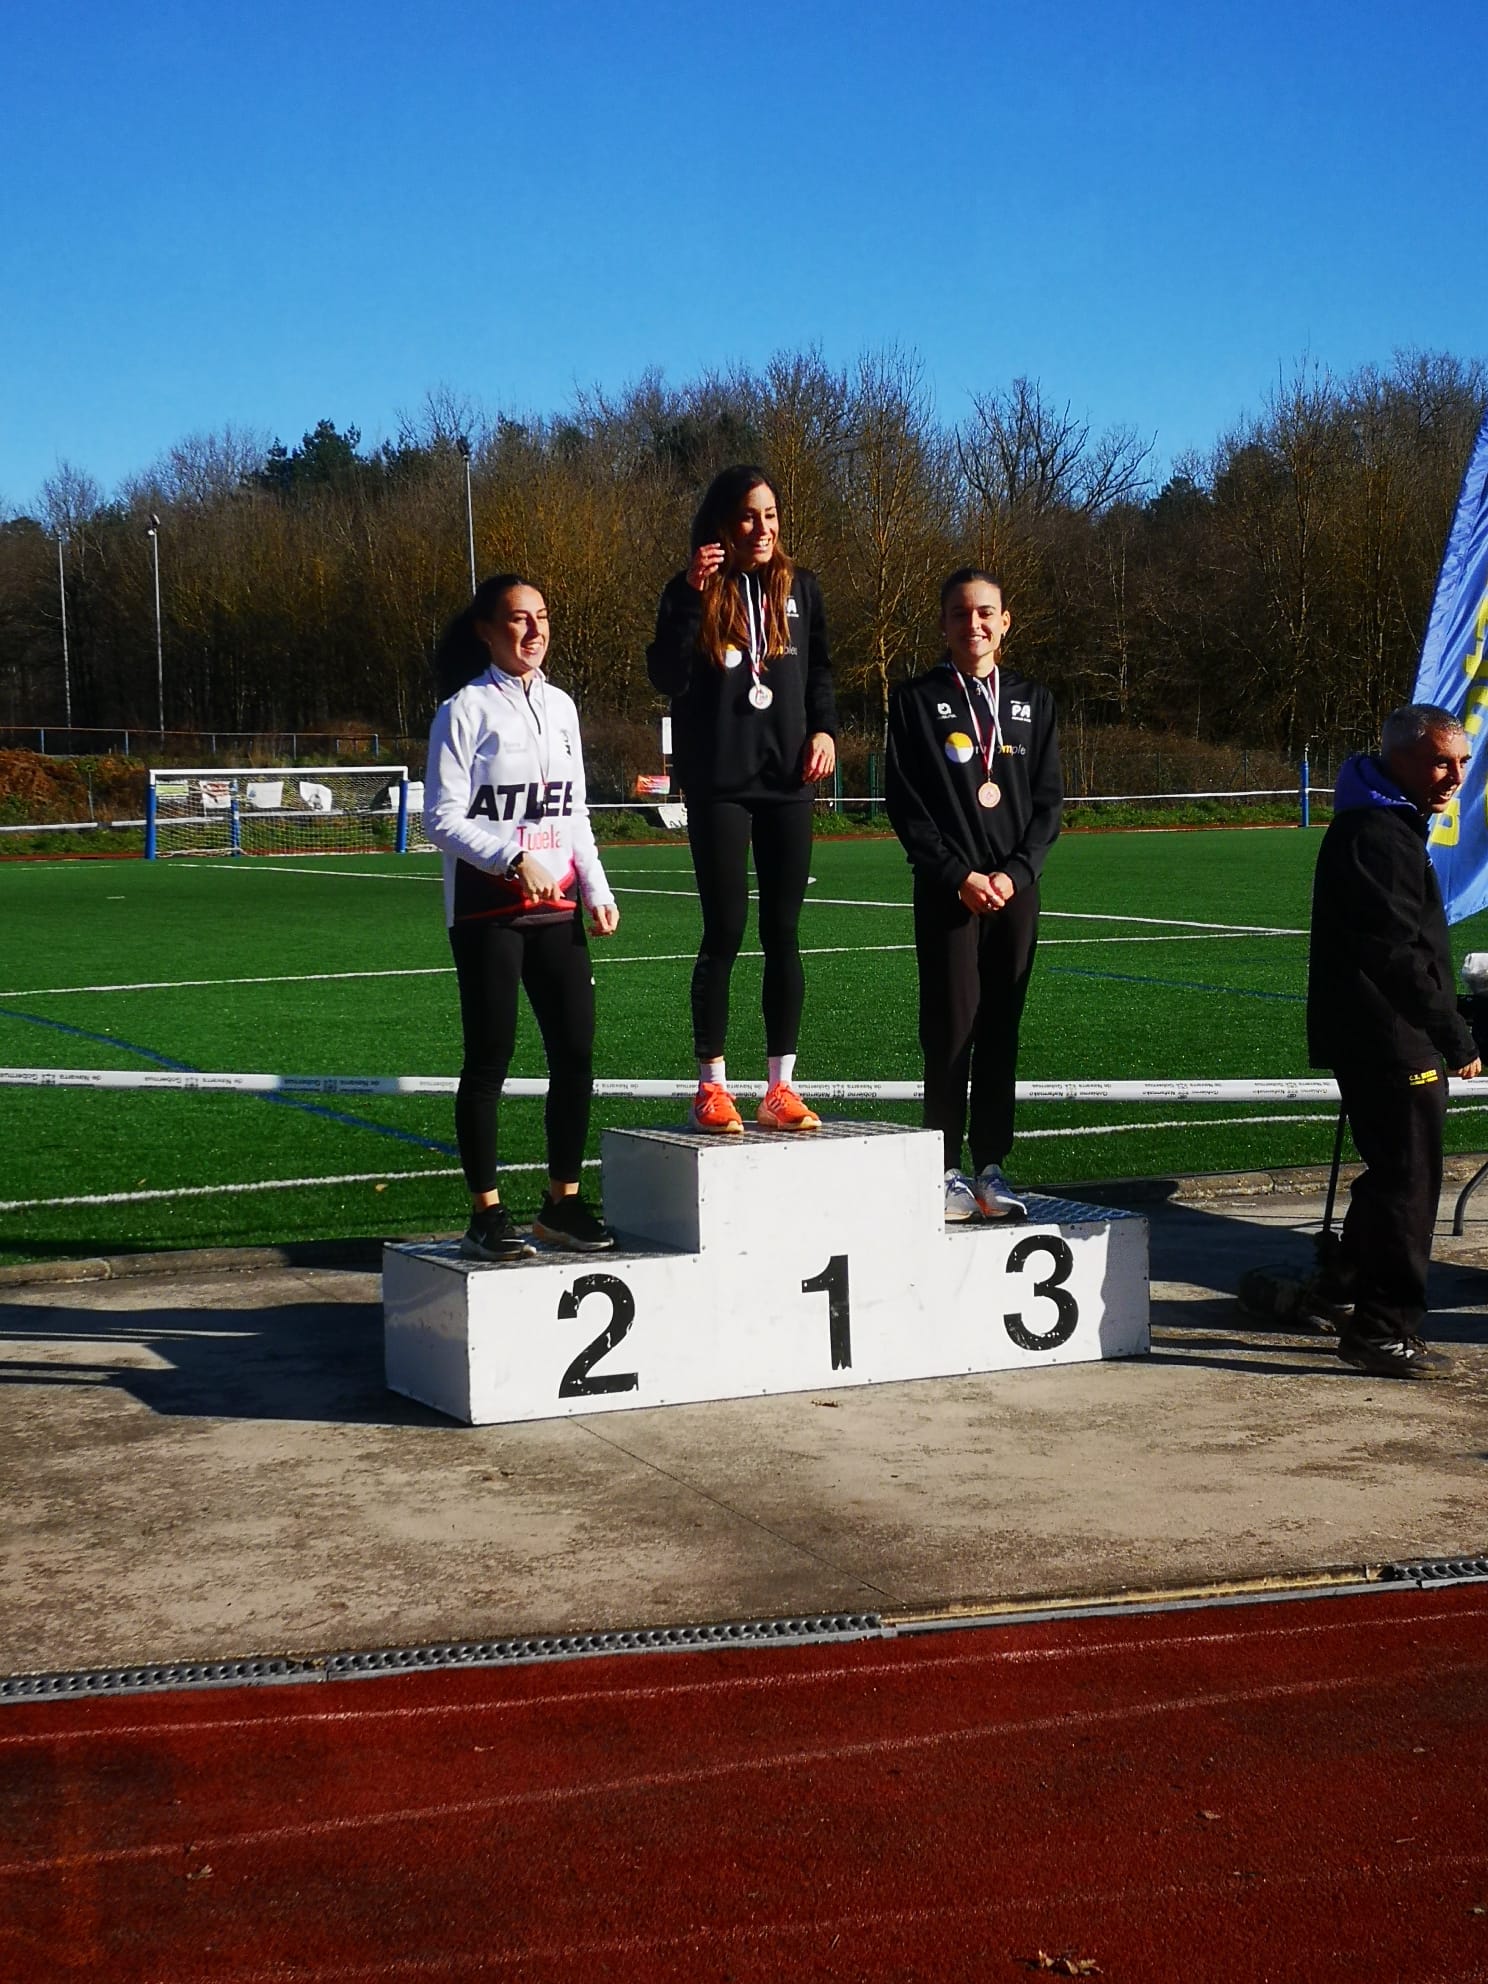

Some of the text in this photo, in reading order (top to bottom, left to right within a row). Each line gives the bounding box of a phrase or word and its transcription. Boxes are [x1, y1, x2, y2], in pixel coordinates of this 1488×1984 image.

[557, 1273, 639, 1399] 2
[801, 1254, 853, 1371] 1
[1004, 1234, 1080, 1351] 3
